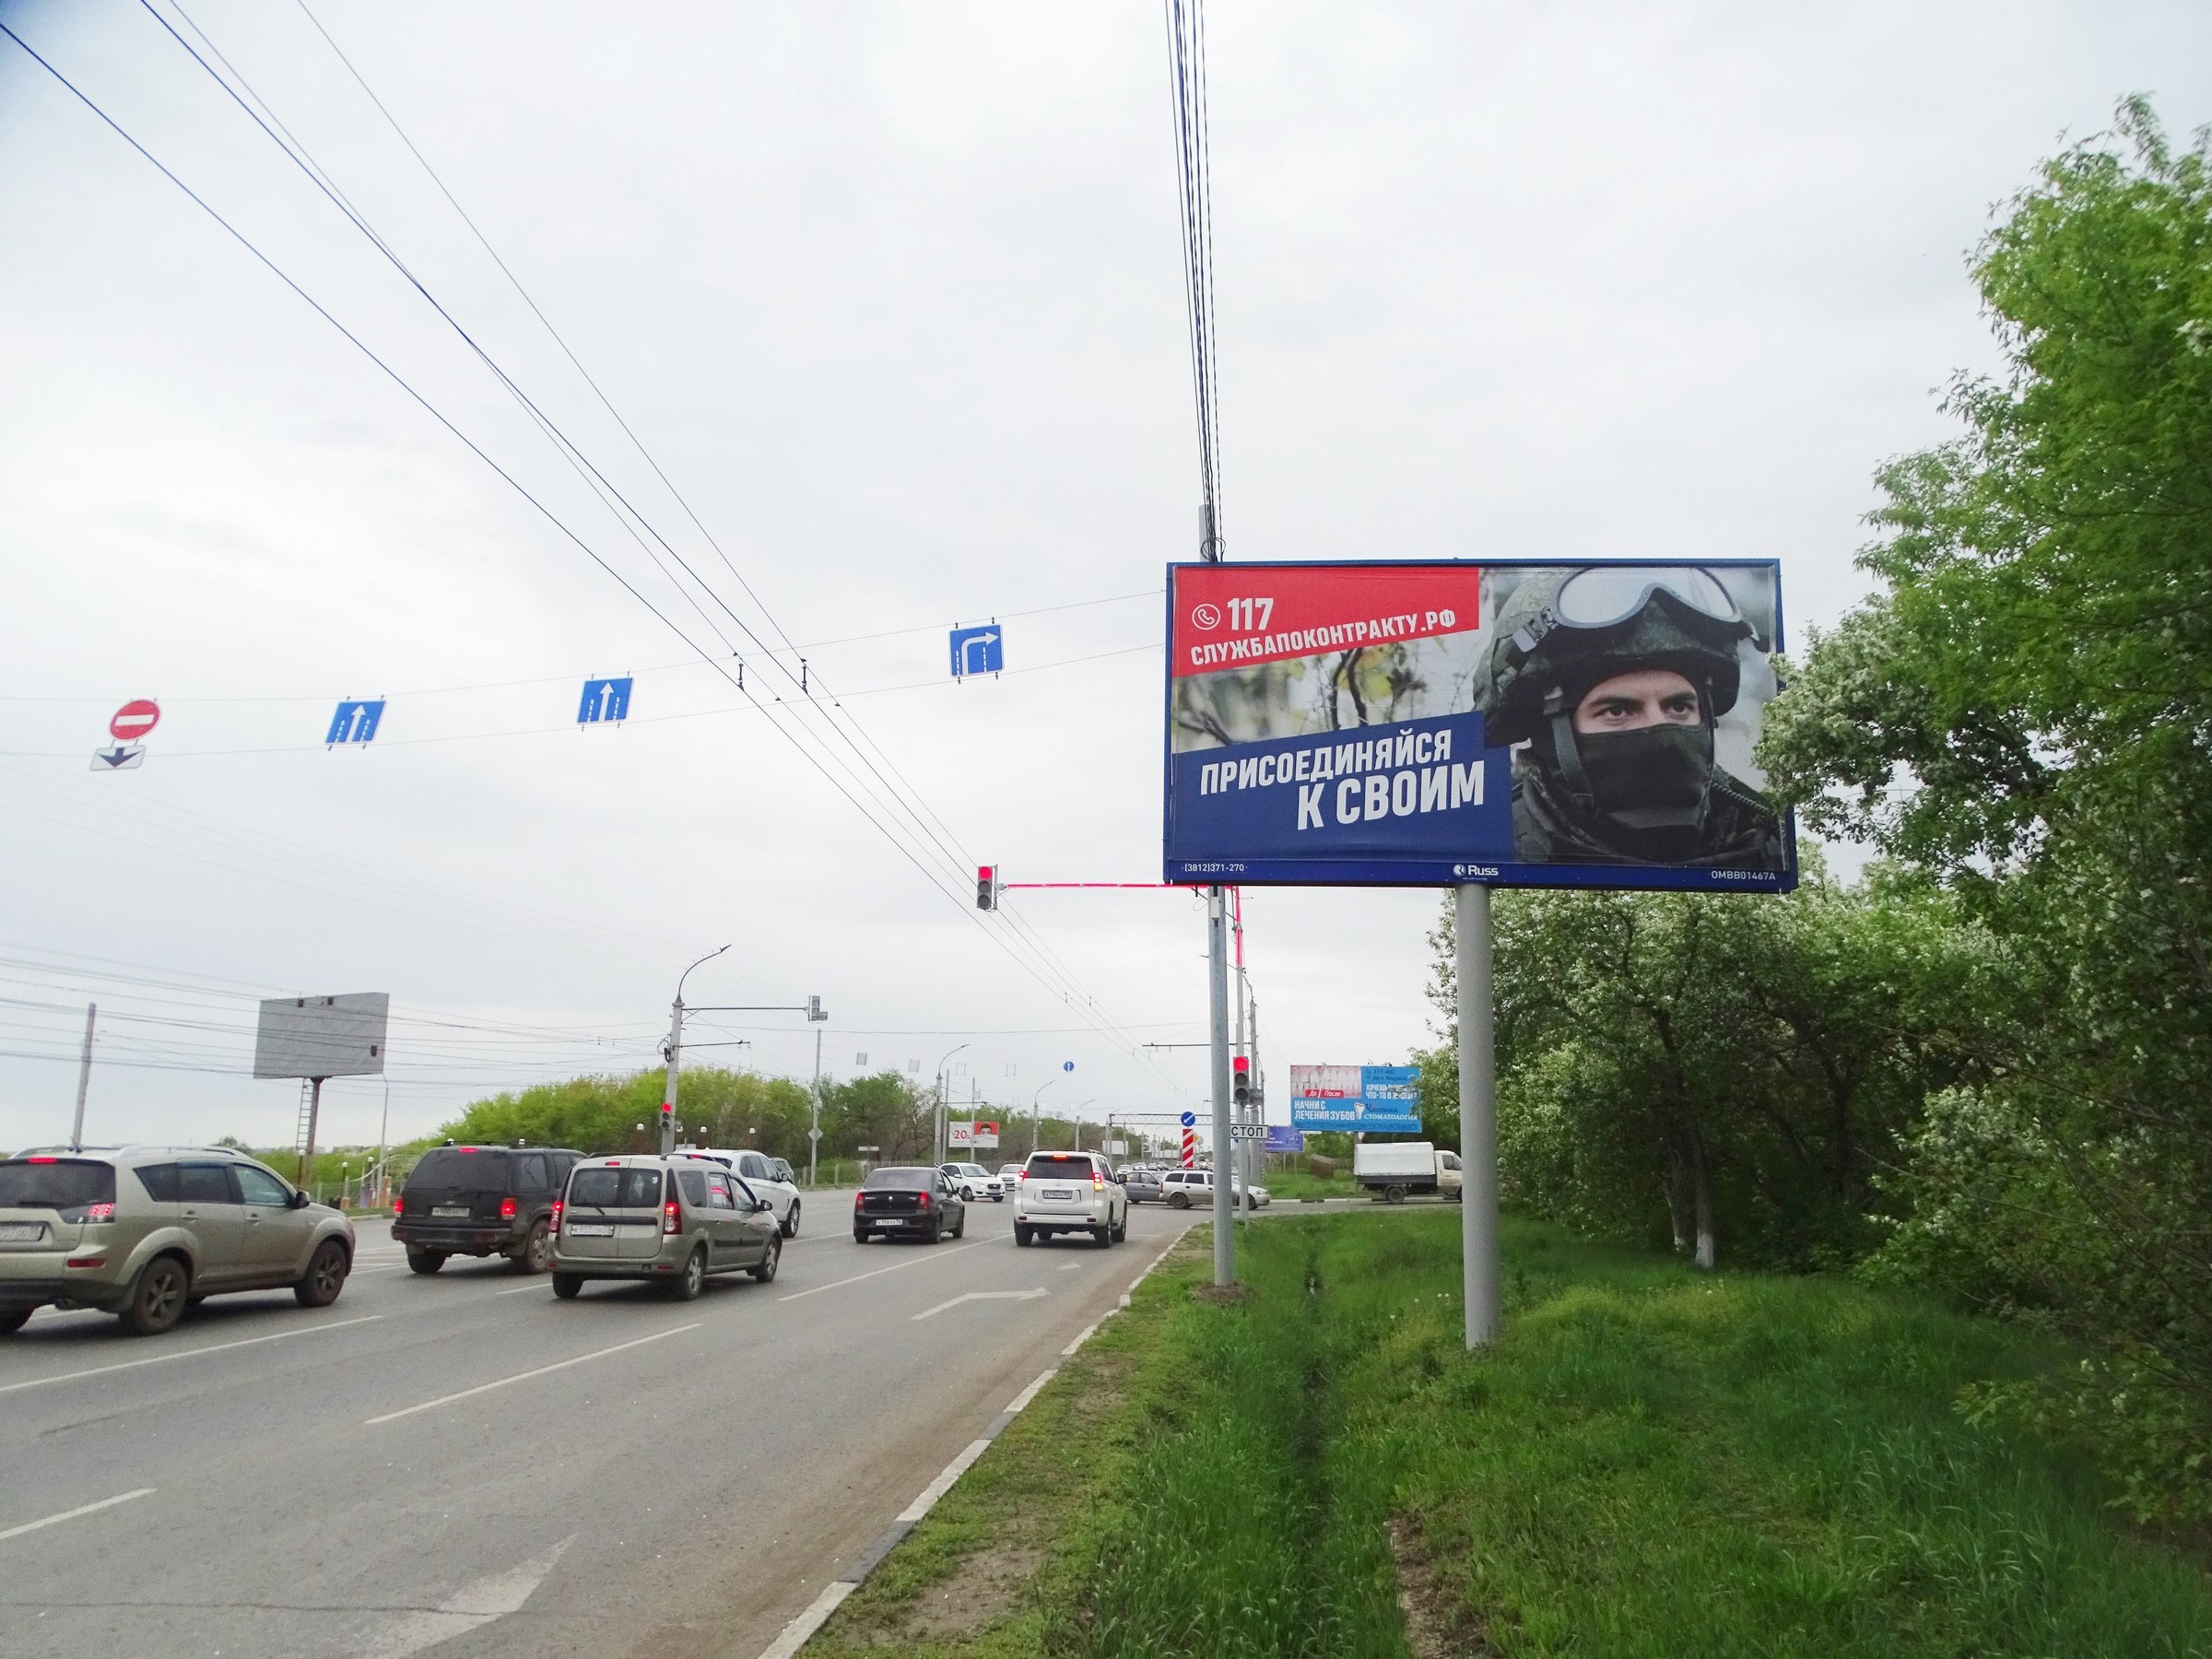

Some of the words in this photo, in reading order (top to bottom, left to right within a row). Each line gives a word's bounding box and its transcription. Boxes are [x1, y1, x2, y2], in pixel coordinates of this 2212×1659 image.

[1227, 597, 1274, 630] 117
[1190, 609, 1456, 665] СЛУЖБАПОКОНТРАКТУ.РФ
[1200, 727, 1452, 795] ПРИСОЕДИНЯЙСЯ
[1297, 784, 1324, 830] К
[1336, 760, 1485, 825] СВОИМ
[1467, 865, 1499, 877] Russ
[1294, 1100, 1319, 1110] НАЧНИ
[1294, 1110, 1329, 1120] ЛЕЧЕНИЯ
[1330, 1111, 1355, 1121] ЗУБОВ
[1230, 1126, 1264, 1137] СТОП
